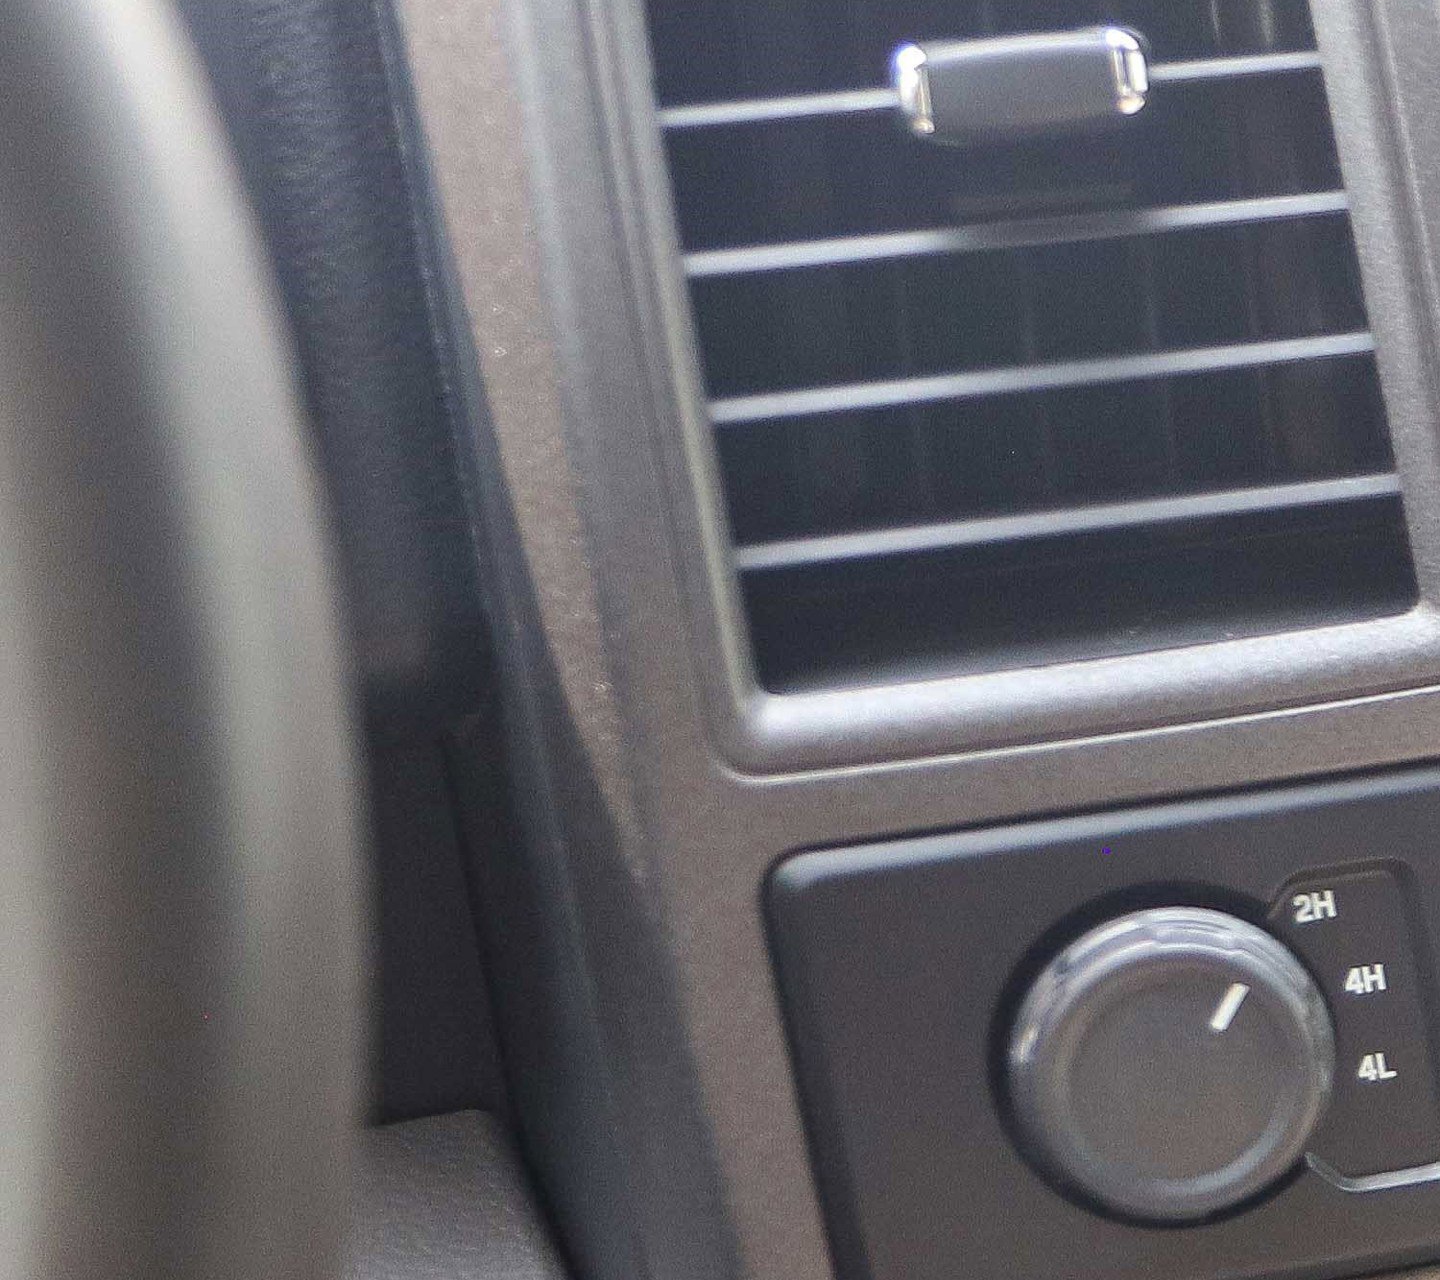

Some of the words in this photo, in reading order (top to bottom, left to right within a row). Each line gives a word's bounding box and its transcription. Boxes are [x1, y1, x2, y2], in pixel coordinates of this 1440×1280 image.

[1294, 891, 1338, 924] 2H
[1345, 964, 1388, 996] 4H
[1358, 1053, 1398, 1082] 4L
